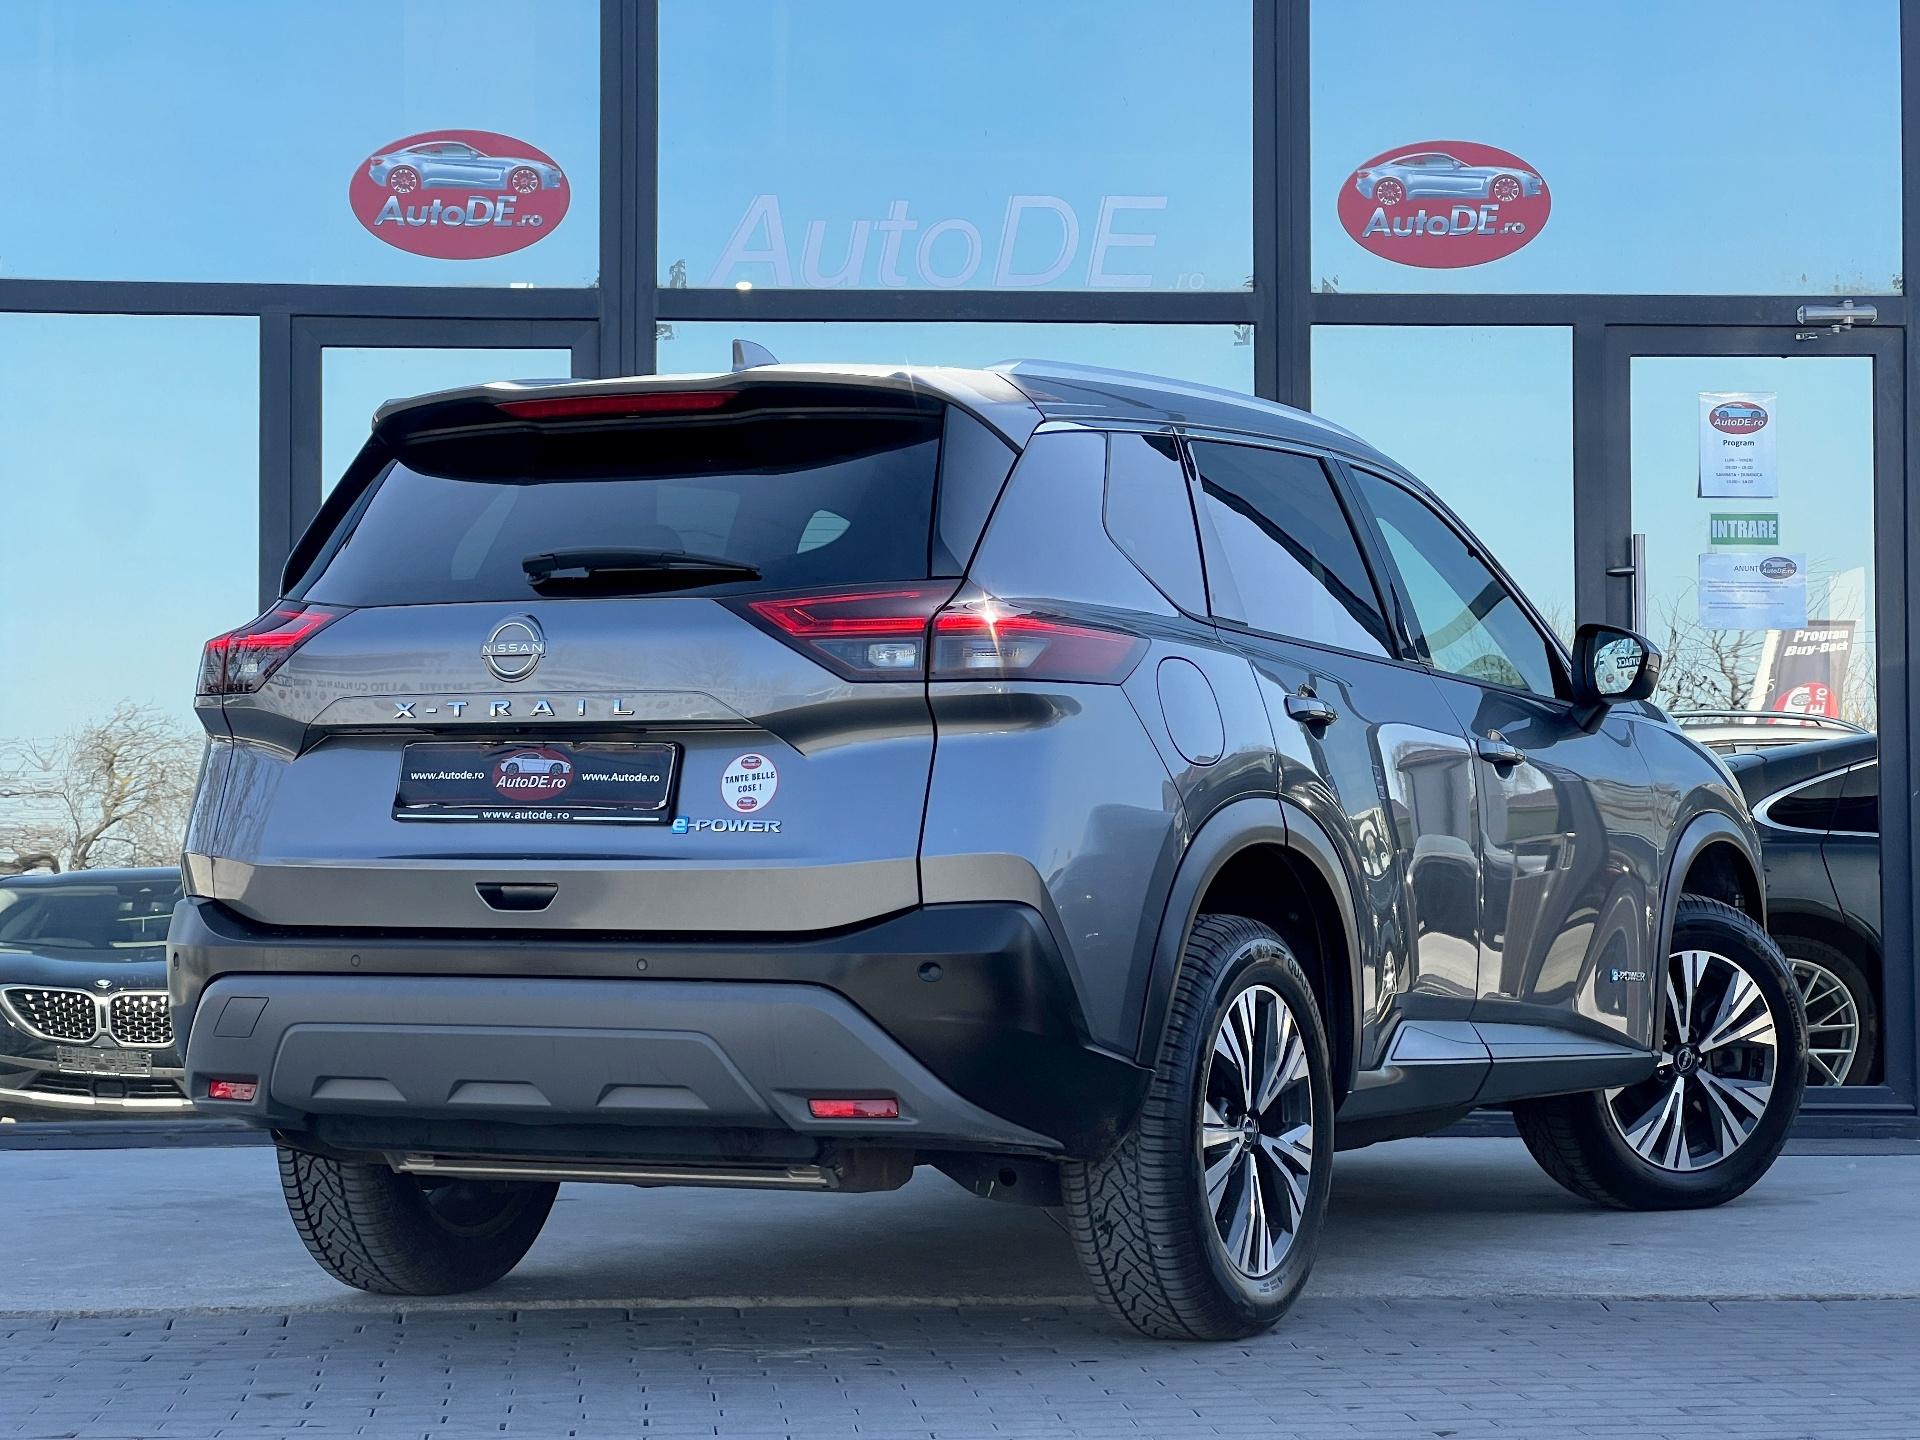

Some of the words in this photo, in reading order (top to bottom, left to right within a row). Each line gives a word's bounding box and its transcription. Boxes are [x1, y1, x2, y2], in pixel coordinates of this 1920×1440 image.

[1714, 418, 1764, 426] AutoDE.ro
[1722, 439, 1755, 448] Program
[1711, 520, 1777, 538] INTRARE
[1793, 630, 1849, 643] Program
[482, 643, 544, 654] NISSAN
[394, 699, 635, 719] X-TRAIL
[410, 770, 485, 781] www.Autode.ro
[581, 771, 660, 783] www.Autode.ro
[725, 773, 750, 784] TANTE
[751, 770, 776, 781] BELLE
[496, 774, 567, 790] AutoDE.ro
[737, 783, 757, 793] COSE
[482, 810, 570, 821] www.autode.ro
[671, 816, 782, 834] e-POWER
